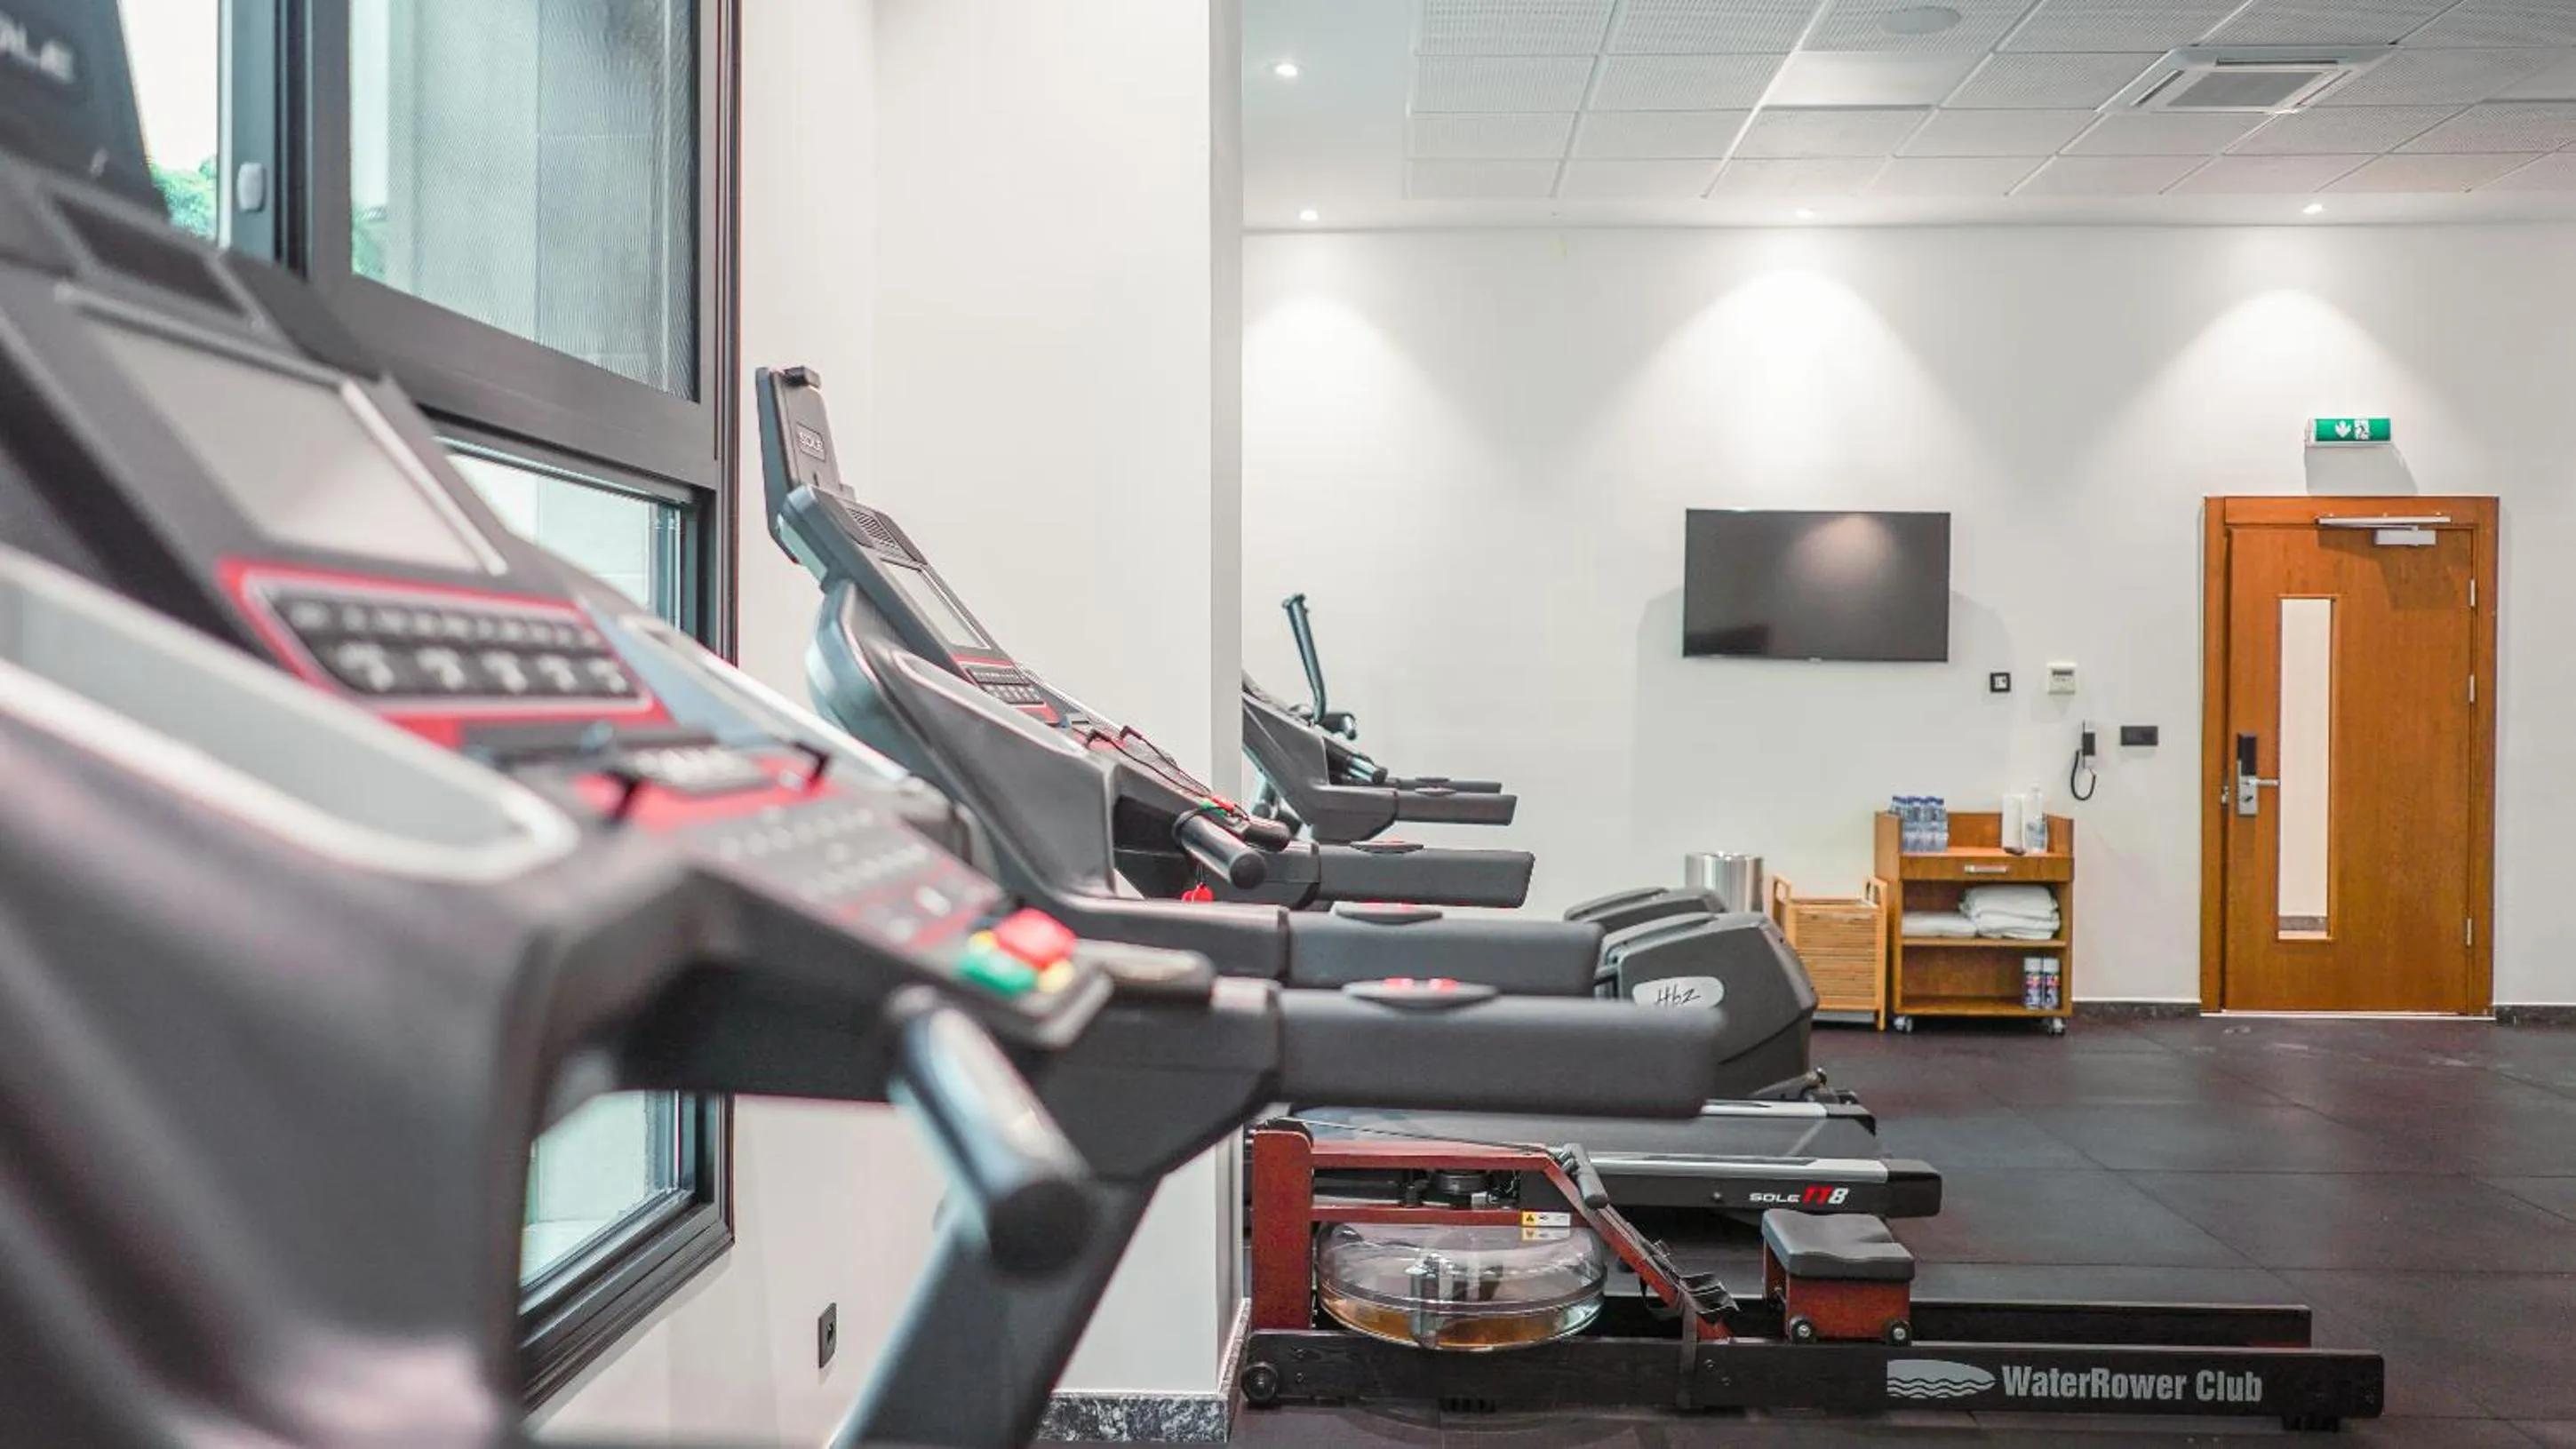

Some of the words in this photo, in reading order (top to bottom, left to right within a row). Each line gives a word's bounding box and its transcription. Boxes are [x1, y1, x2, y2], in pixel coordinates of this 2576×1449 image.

[1749, 1192, 1800, 1203] SOLE
[2001, 1365, 2187, 1400] WaterRower
[2196, 1369, 2262, 1402] Club
